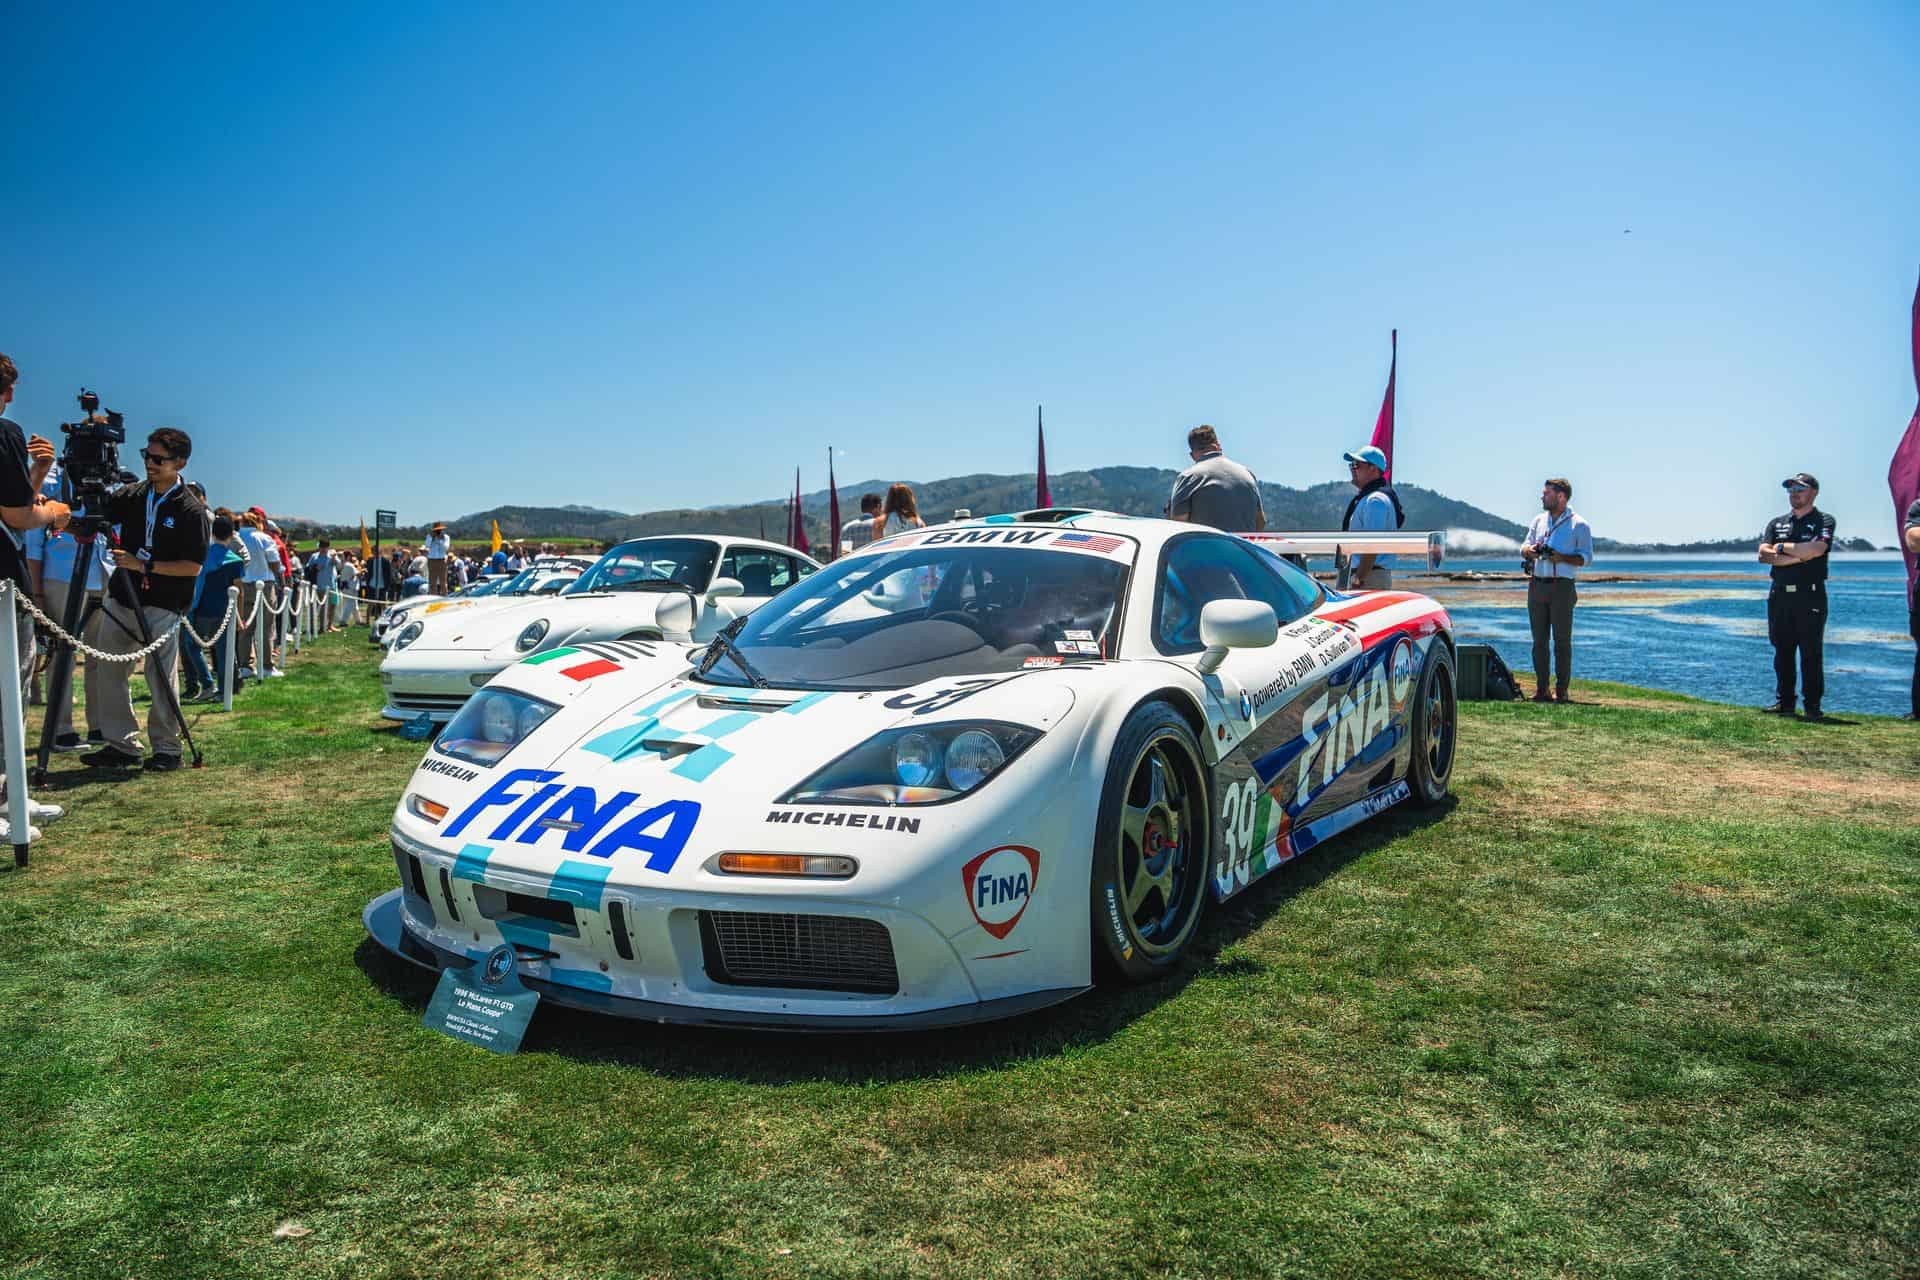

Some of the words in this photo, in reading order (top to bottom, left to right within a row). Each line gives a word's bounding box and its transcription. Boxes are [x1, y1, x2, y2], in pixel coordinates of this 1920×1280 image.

[920, 531, 1051, 545] BMW
[1254, 671, 1287, 713] powered
[1284, 667, 1297, 687] by
[1292, 652, 1316, 678] BMW
[1297, 661, 1390, 806] FINA
[421, 758, 479, 782] MICHELIN
[441, 769, 702, 874] FINA
[766, 811, 921, 834] MICHELIN
[1216, 777, 1258, 896] 39
[978, 872, 1029, 908] FINA
[1106, 889, 1126, 948] MICHELIN
[457, 999, 466, 1007] Le
